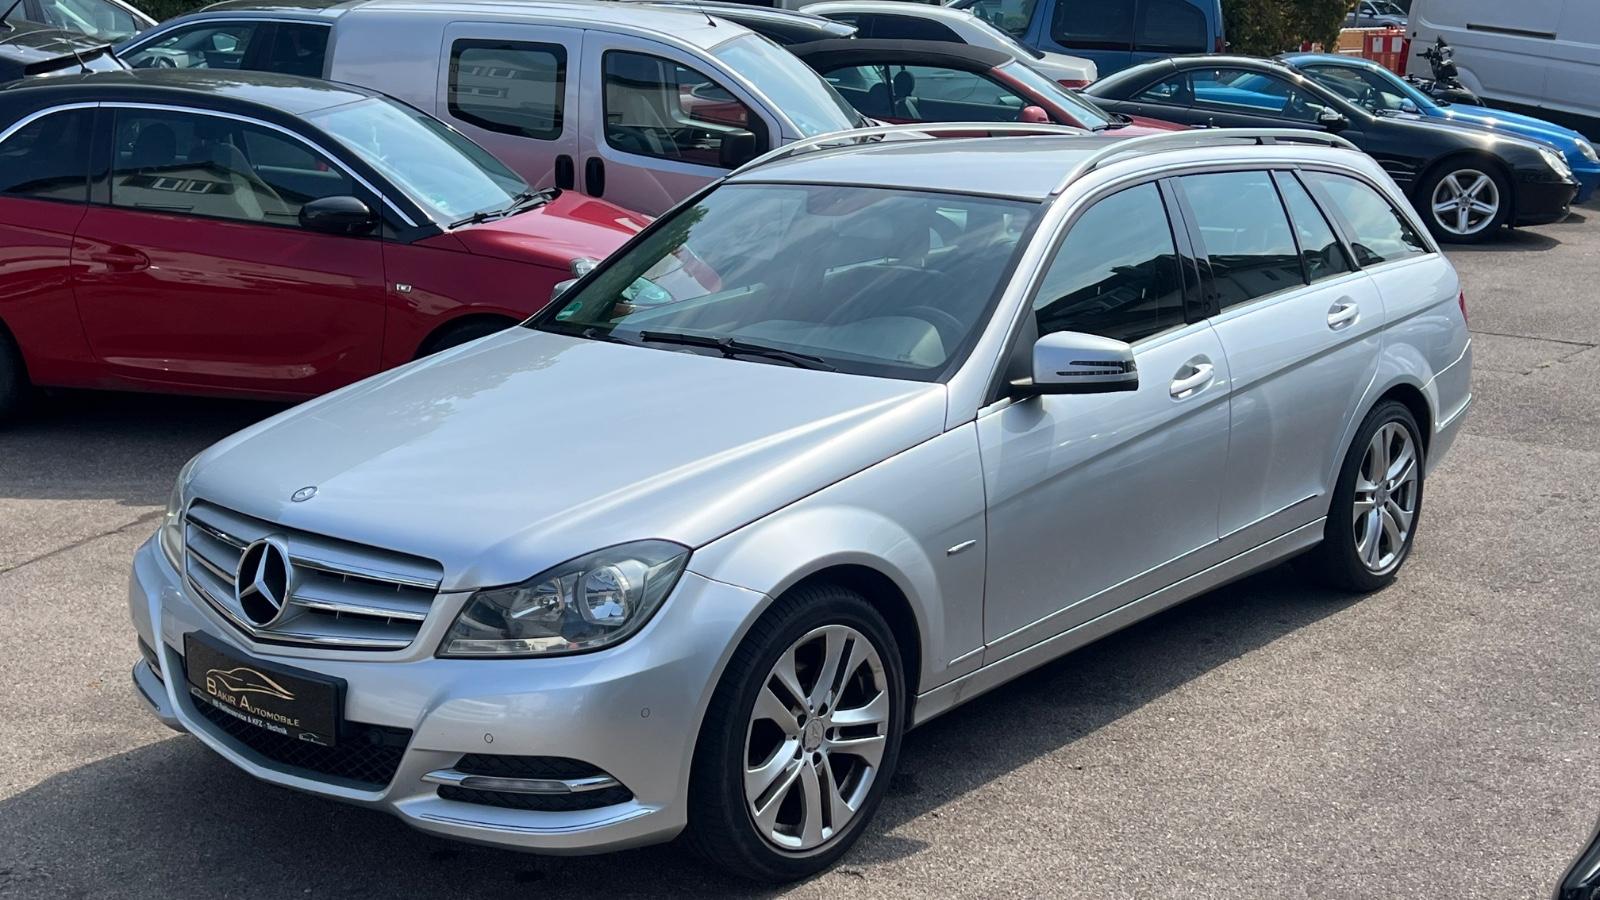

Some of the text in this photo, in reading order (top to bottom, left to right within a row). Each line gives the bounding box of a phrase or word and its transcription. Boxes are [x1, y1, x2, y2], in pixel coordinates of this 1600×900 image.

[206, 677, 236, 704] BAKIR
[240, 695, 300, 727] AUTOMOBILE
[266, 723, 288, 735] Technik
